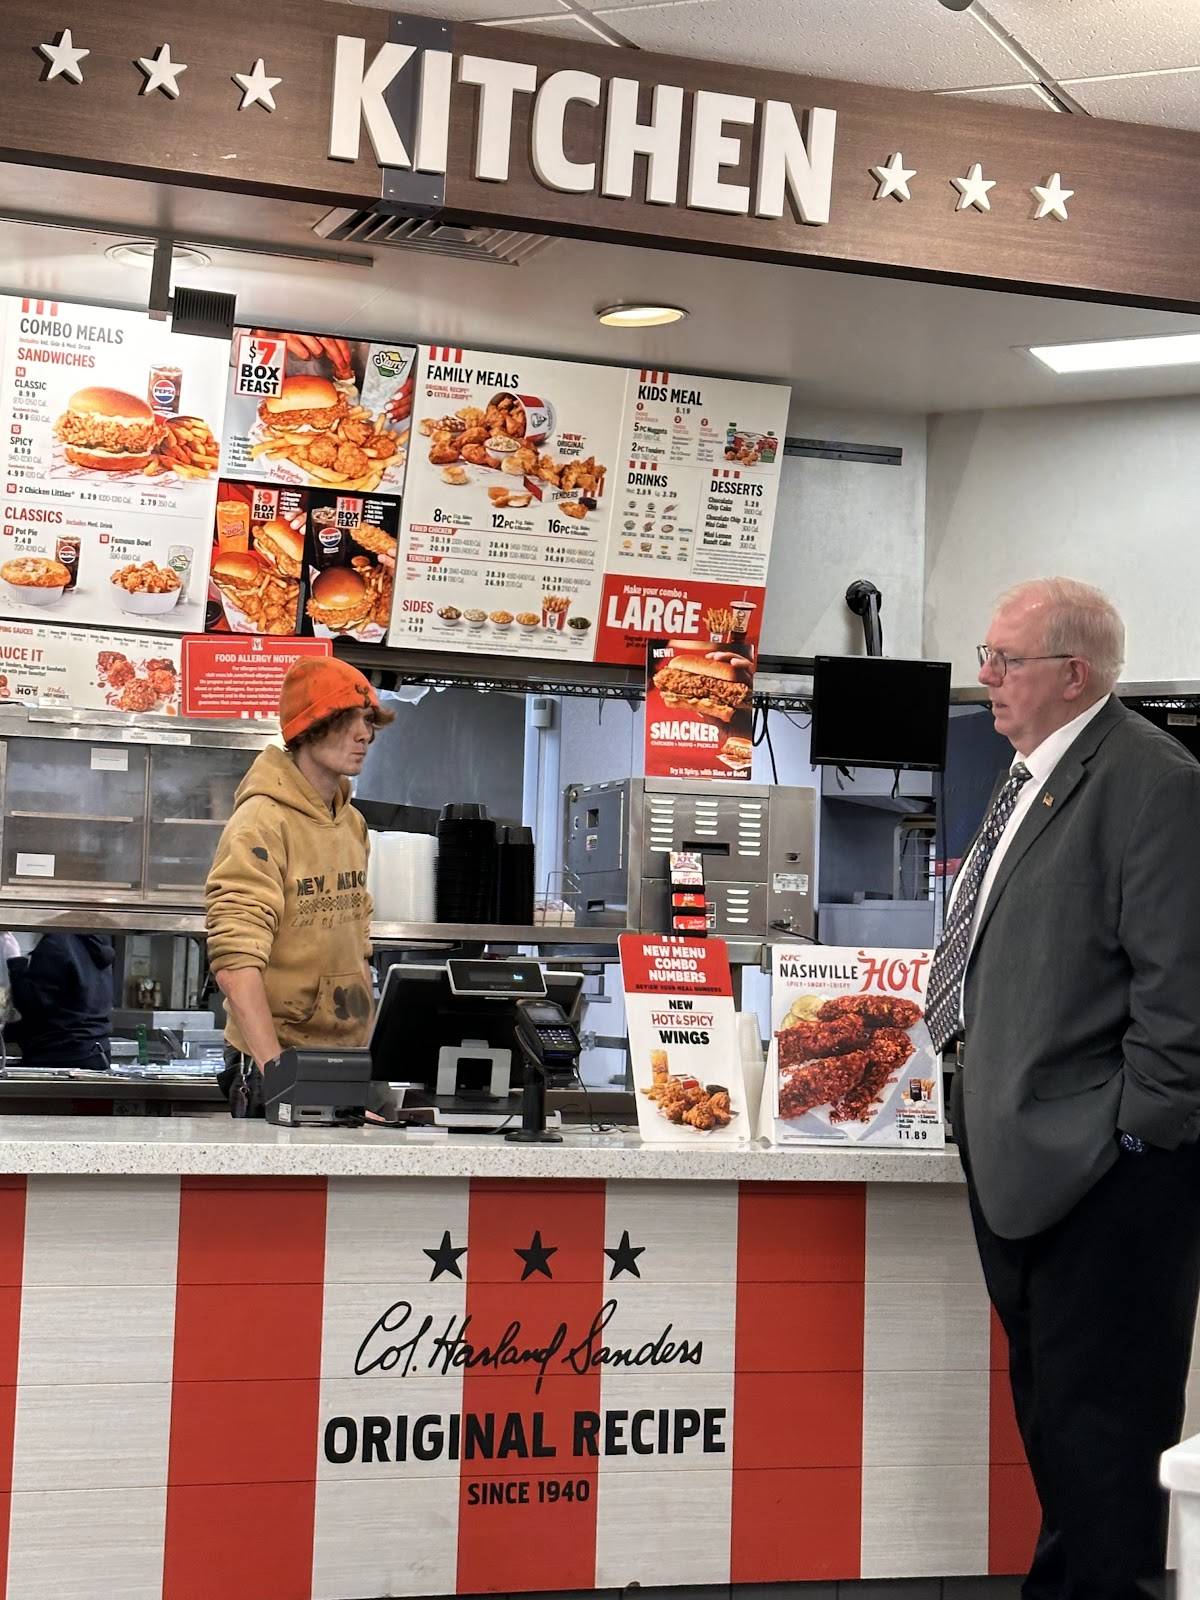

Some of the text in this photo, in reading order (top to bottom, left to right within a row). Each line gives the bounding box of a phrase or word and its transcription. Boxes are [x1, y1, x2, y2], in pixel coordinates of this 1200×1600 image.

[328, 35, 838, 225] KITCHEN
[20, 318, 124, 344] COMBO MEALS
[17, 347, 96, 368] SANDWICHES
[249, 340, 277, 365] $7
[373, 351, 407, 375] Starry
[241, 364, 280, 381] BOX
[427, 364, 519, 389] FAMILY MEALS
[14, 379, 47, 390] CLASSIC
[240, 379, 279, 395] FEAST
[638, 385, 703, 406] KIDS MEAL
[562, 433, 582, 441] NEW
[647, 426, 668, 435] Nuggets
[10, 436, 33, 446] SPICY
[557, 440, 584, 449] ORIGINAL
[560, 447, 580, 456] RECIPE
[646, 446, 665, 454] Tenders
[628, 472, 668, 487] DRINKS
[24, 487, 50, 495] Chicken
[710, 480, 763, 497] DESSERTS
[257, 491, 273, 504] $9
[551, 490, 578, 501] TENDERS
[708, 497, 733, 505] Chocolate
[5, 506, 63, 523] CLASSICS
[254, 504, 275, 513] BOX
[253, 511, 274, 520] FEAST
[338, 512, 360, 520] BOX
[706, 514, 741, 524] Chocolate Chip
[337, 519, 359, 528] FEAST
[411, 524, 453, 535] FRIED CHICKEN
[111, 536, 135, 545] Famous
[715, 532, 732, 540] Lemon
[623, 584, 688, 599] Make your combo a
[402, 600, 434, 614] SIDES
[606, 595, 702, 634] LARGE
[13, 627, 33, 635] SAUCES
[31, 649, 44, 662] IT
[214, 654, 301, 664] FOOD ALLERGY NOTIC
[650, 720, 720, 742] SNACKER
[669, 766, 678, 775] Try
[700, 768, 712, 776] with
[297, 875, 325, 896] NEW
[642, 944, 706, 959] NEW MENU
[780, 954, 801, 962] KFC
[654, 958, 698, 970] COMBO
[648, 969, 707, 983] NUMBERS
[780, 950, 930, 993] NASHVILLE HOT
[669, 999, 693, 1011] NEW
[659, 1030, 710, 1045] WINGS
[898, 1130, 927, 1140] 11.89
[354, 1298, 703, 1395] Col. Harland Sanders
[324, 1407, 727, 1464] ORIGINAL RECIPE
[467, 1479, 590, 1506] SINCE 1940
